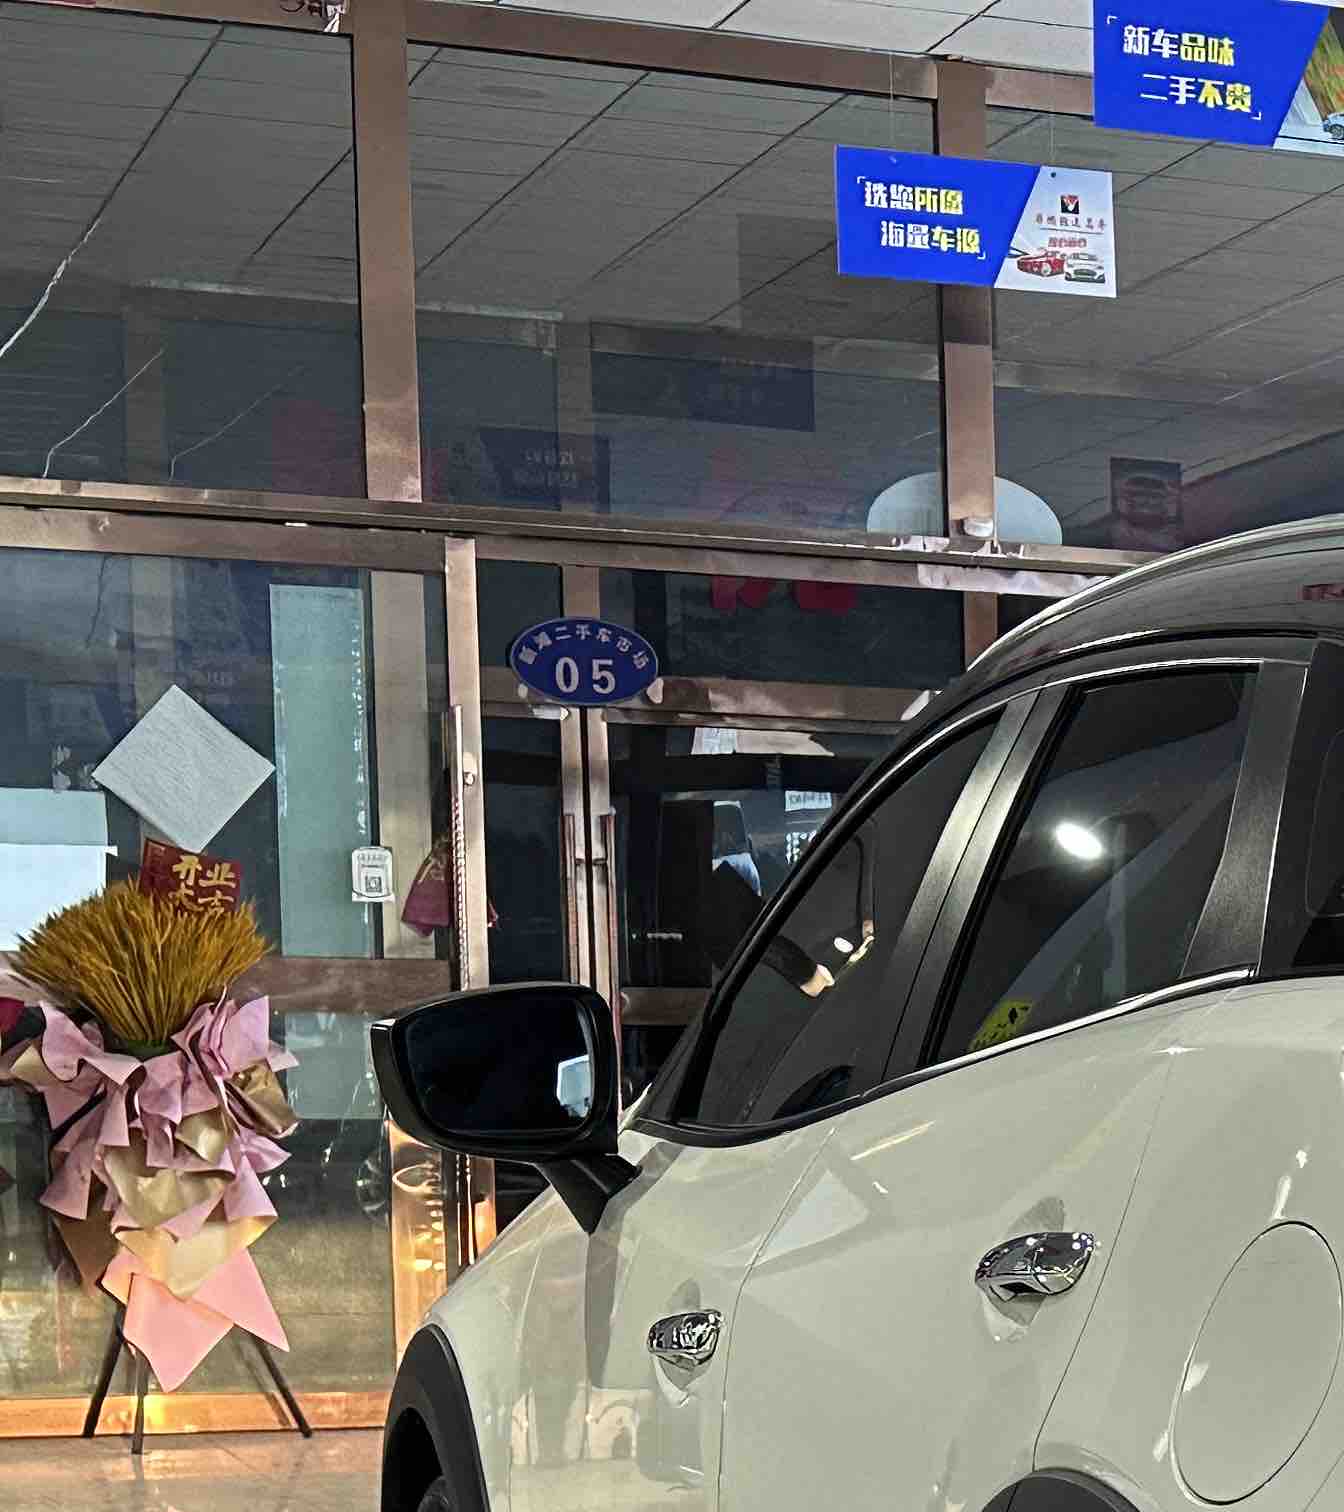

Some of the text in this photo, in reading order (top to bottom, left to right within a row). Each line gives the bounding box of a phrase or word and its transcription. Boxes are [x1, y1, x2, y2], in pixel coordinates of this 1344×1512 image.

[1123, 24, 1235, 67] 新车品味
[1140, 73, 1252, 113] 二手不贵
[555, 656, 616, 694] 05
